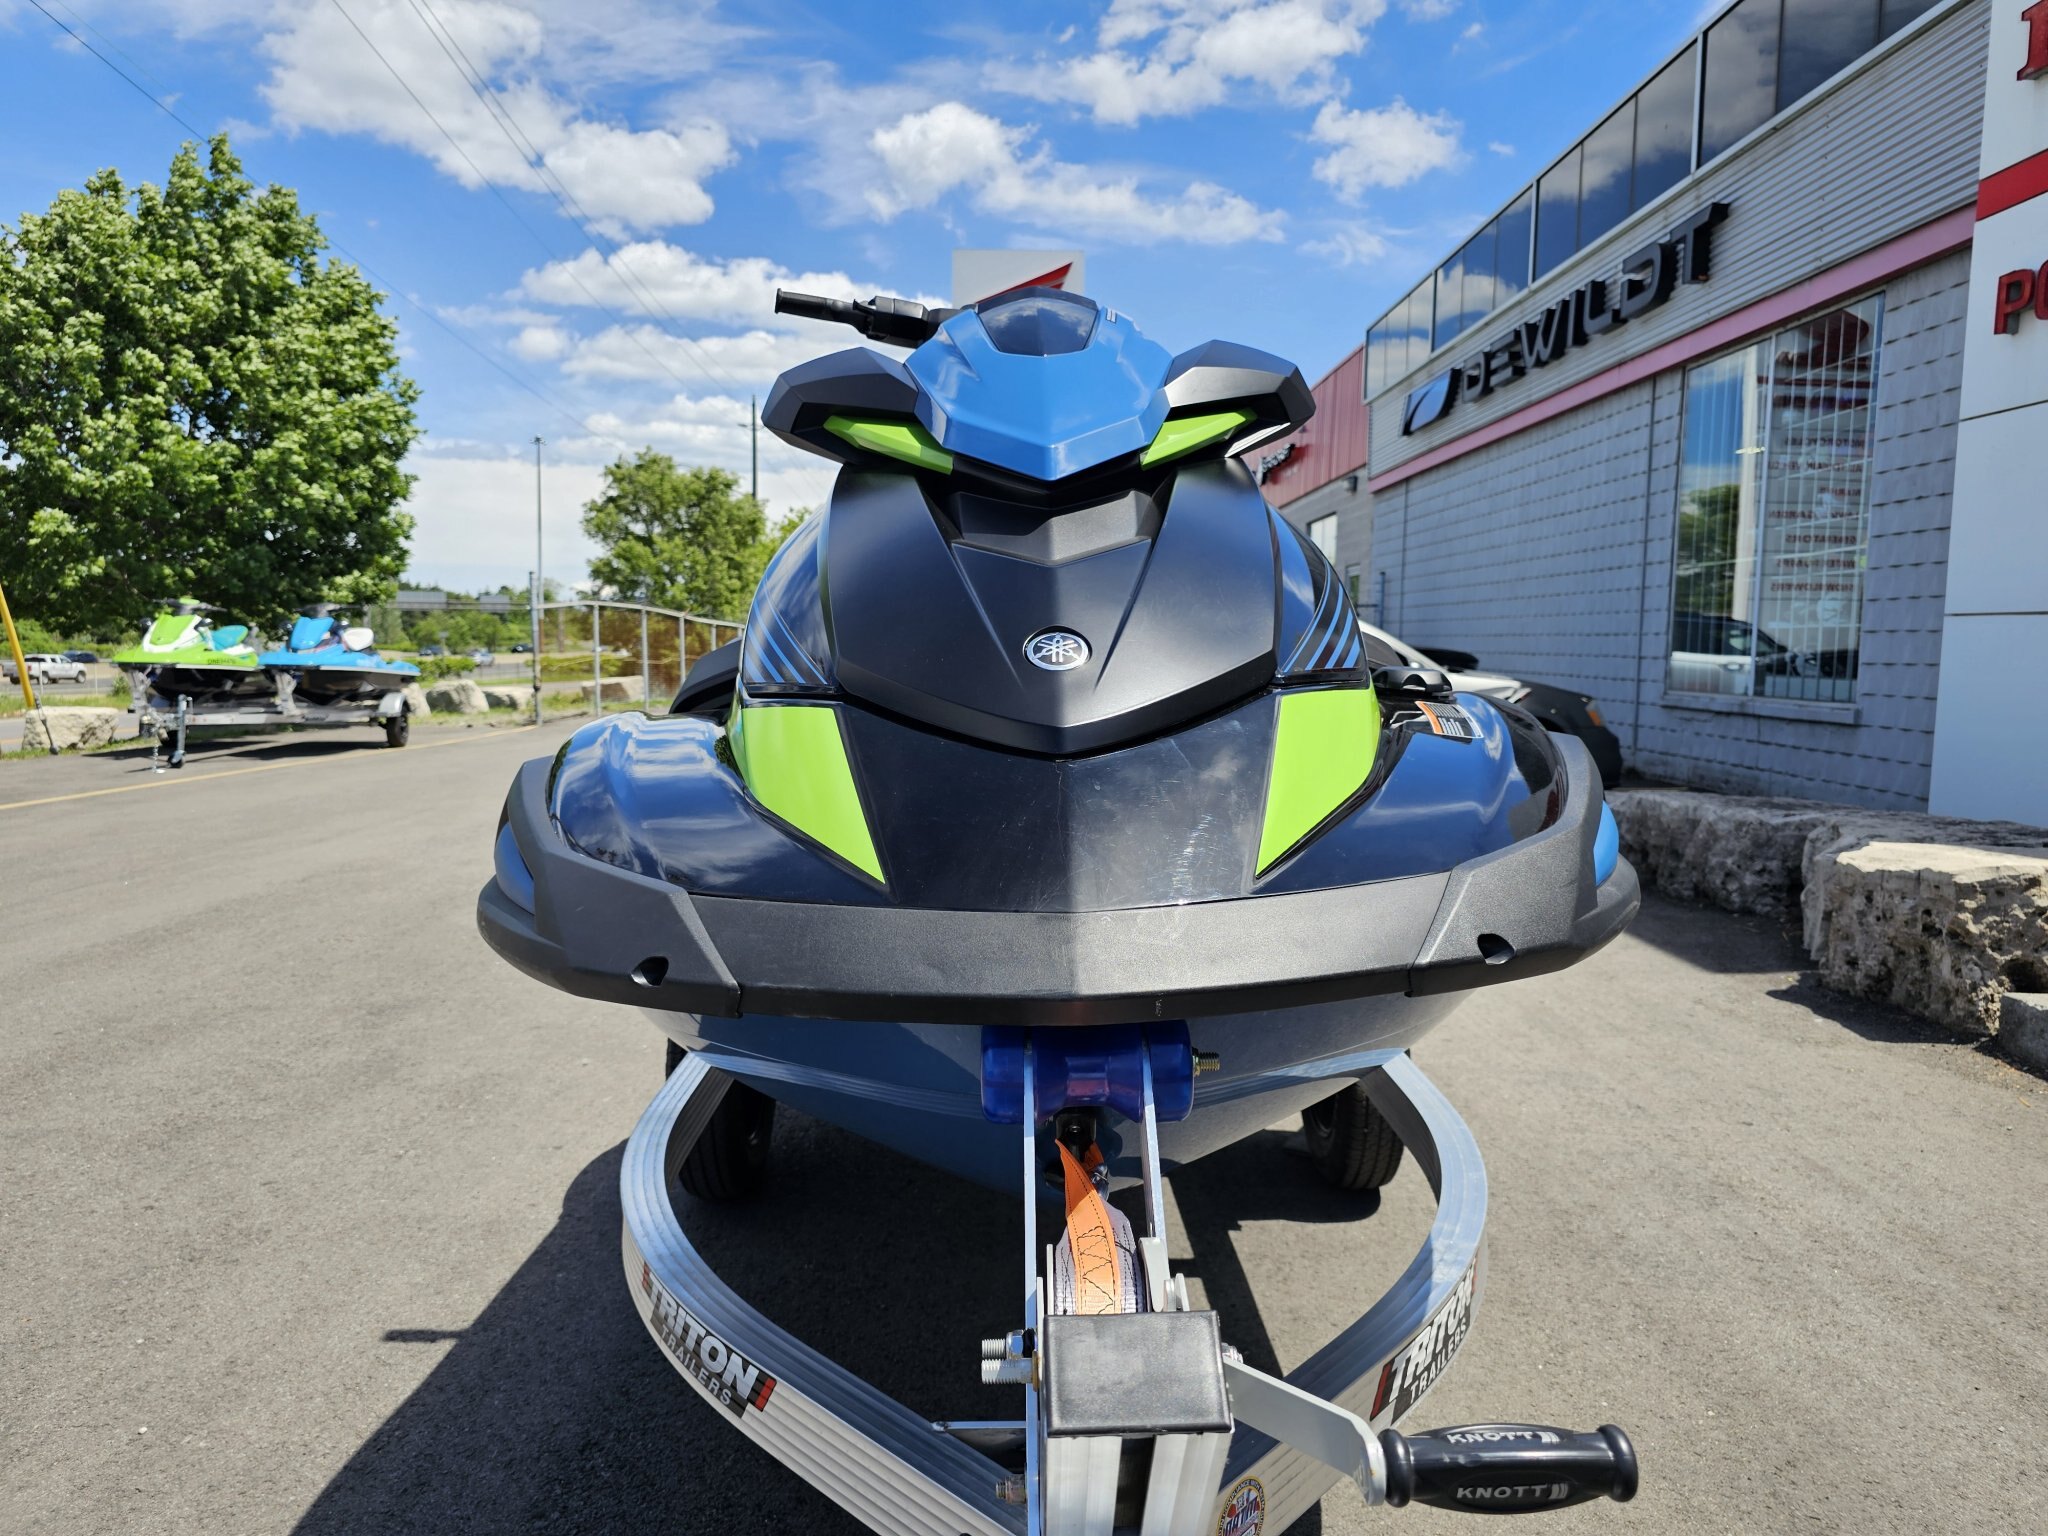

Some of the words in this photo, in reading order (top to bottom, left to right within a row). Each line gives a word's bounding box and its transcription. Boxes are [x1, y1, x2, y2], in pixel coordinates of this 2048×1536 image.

[1462, 203, 1729, 404] DEWILDT
[650, 1271, 760, 1400] TRITON
[661, 1324, 732, 1405] TRAILERS
[1389, 1258, 1476, 1403] TRITON
[1410, 1317, 1467, 1404] TRAILERS
[1446, 1431, 1533, 1444] KNOTT
[1456, 1484, 1548, 1499] KNOTT
